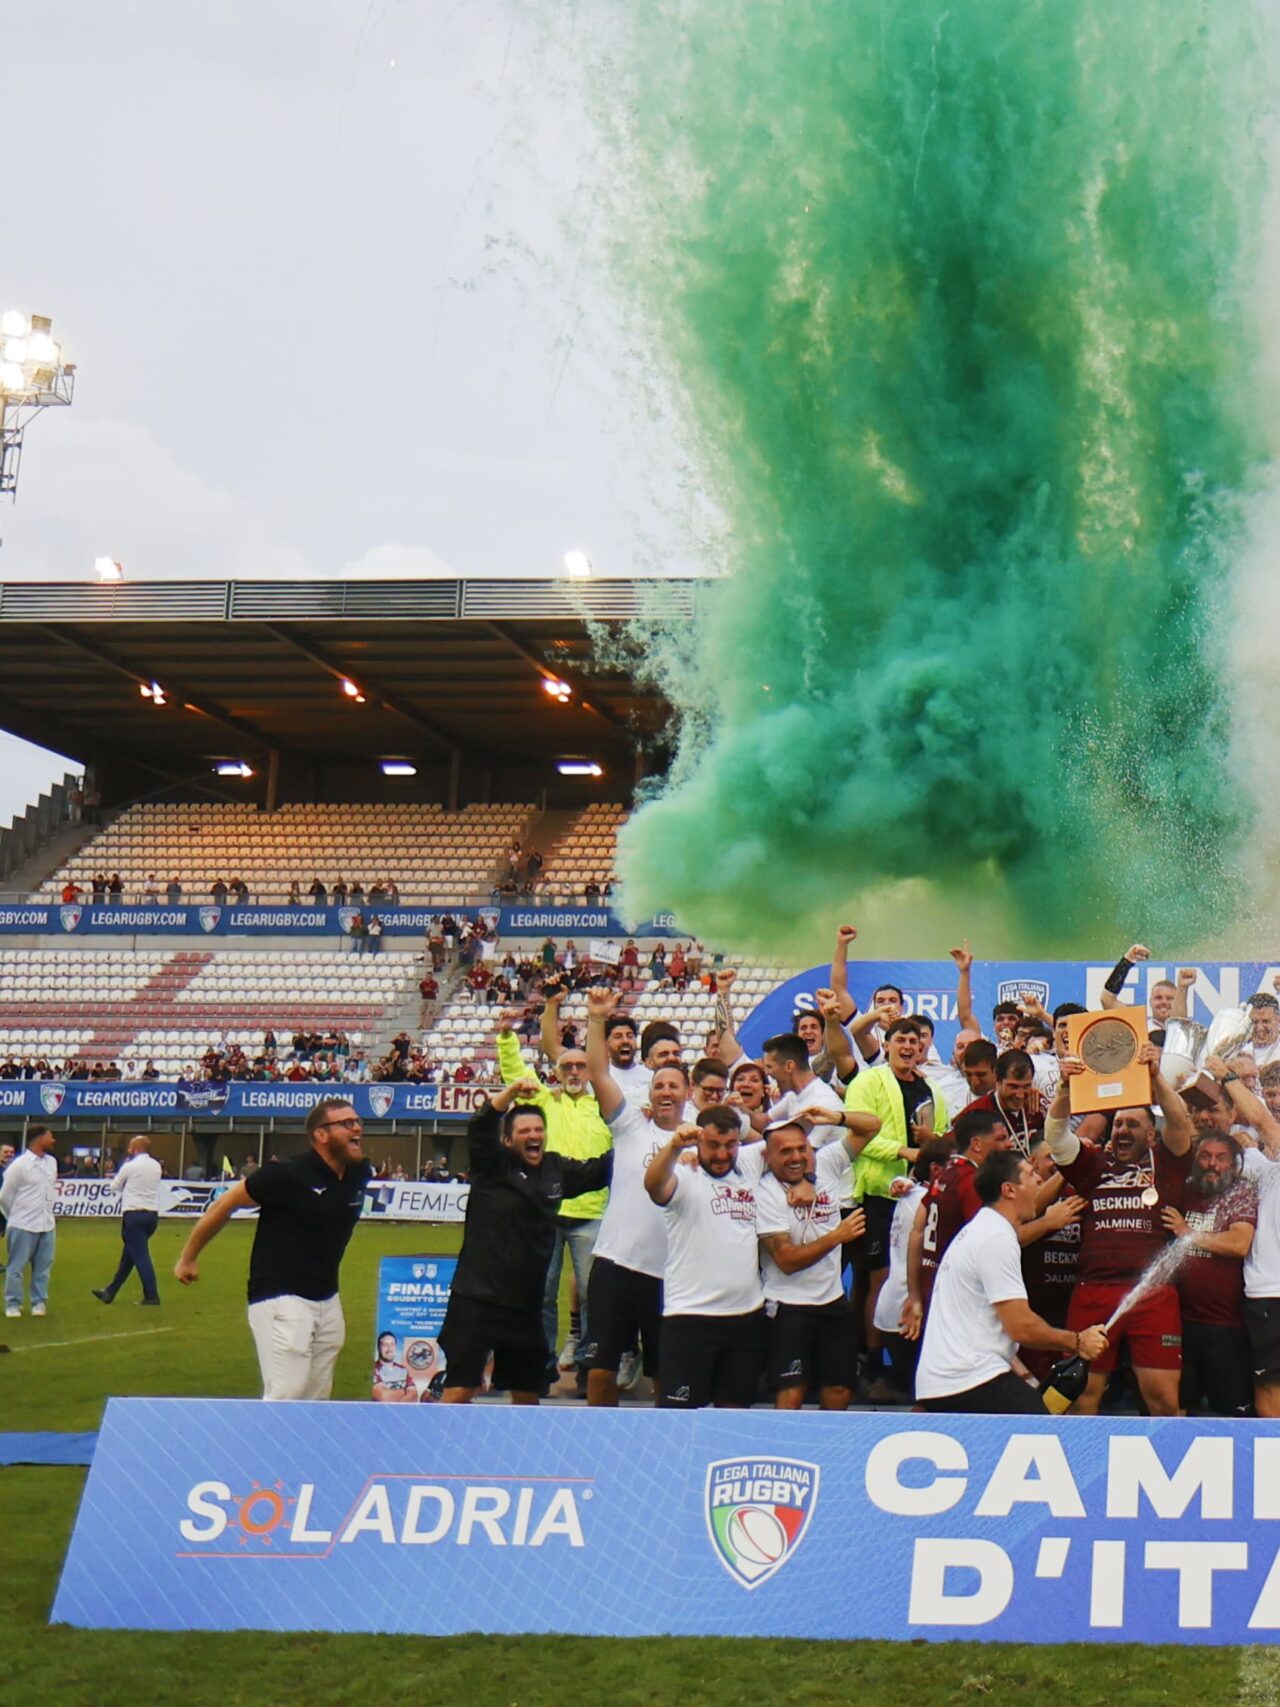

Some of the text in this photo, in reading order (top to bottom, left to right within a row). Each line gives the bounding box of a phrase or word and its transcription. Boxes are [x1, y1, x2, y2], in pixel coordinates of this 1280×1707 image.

[91, 911, 187, 926] LEGARUGBY.COM
[230, 913, 326, 927] LEGARUGBY.COM
[511, 914, 607, 928] LEGARUGBY.COM
[77, 1091, 178, 1107] LEGARUGBY.CO
[54, 1180, 116, 1201] Range
[1092, 1196, 1153, 1212] BECKHO
[924, 1203, 939, 1252] 8
[715, 1463, 810, 1486] LEGA ITALIANA
[713, 1479, 810, 1507] RUGBY
